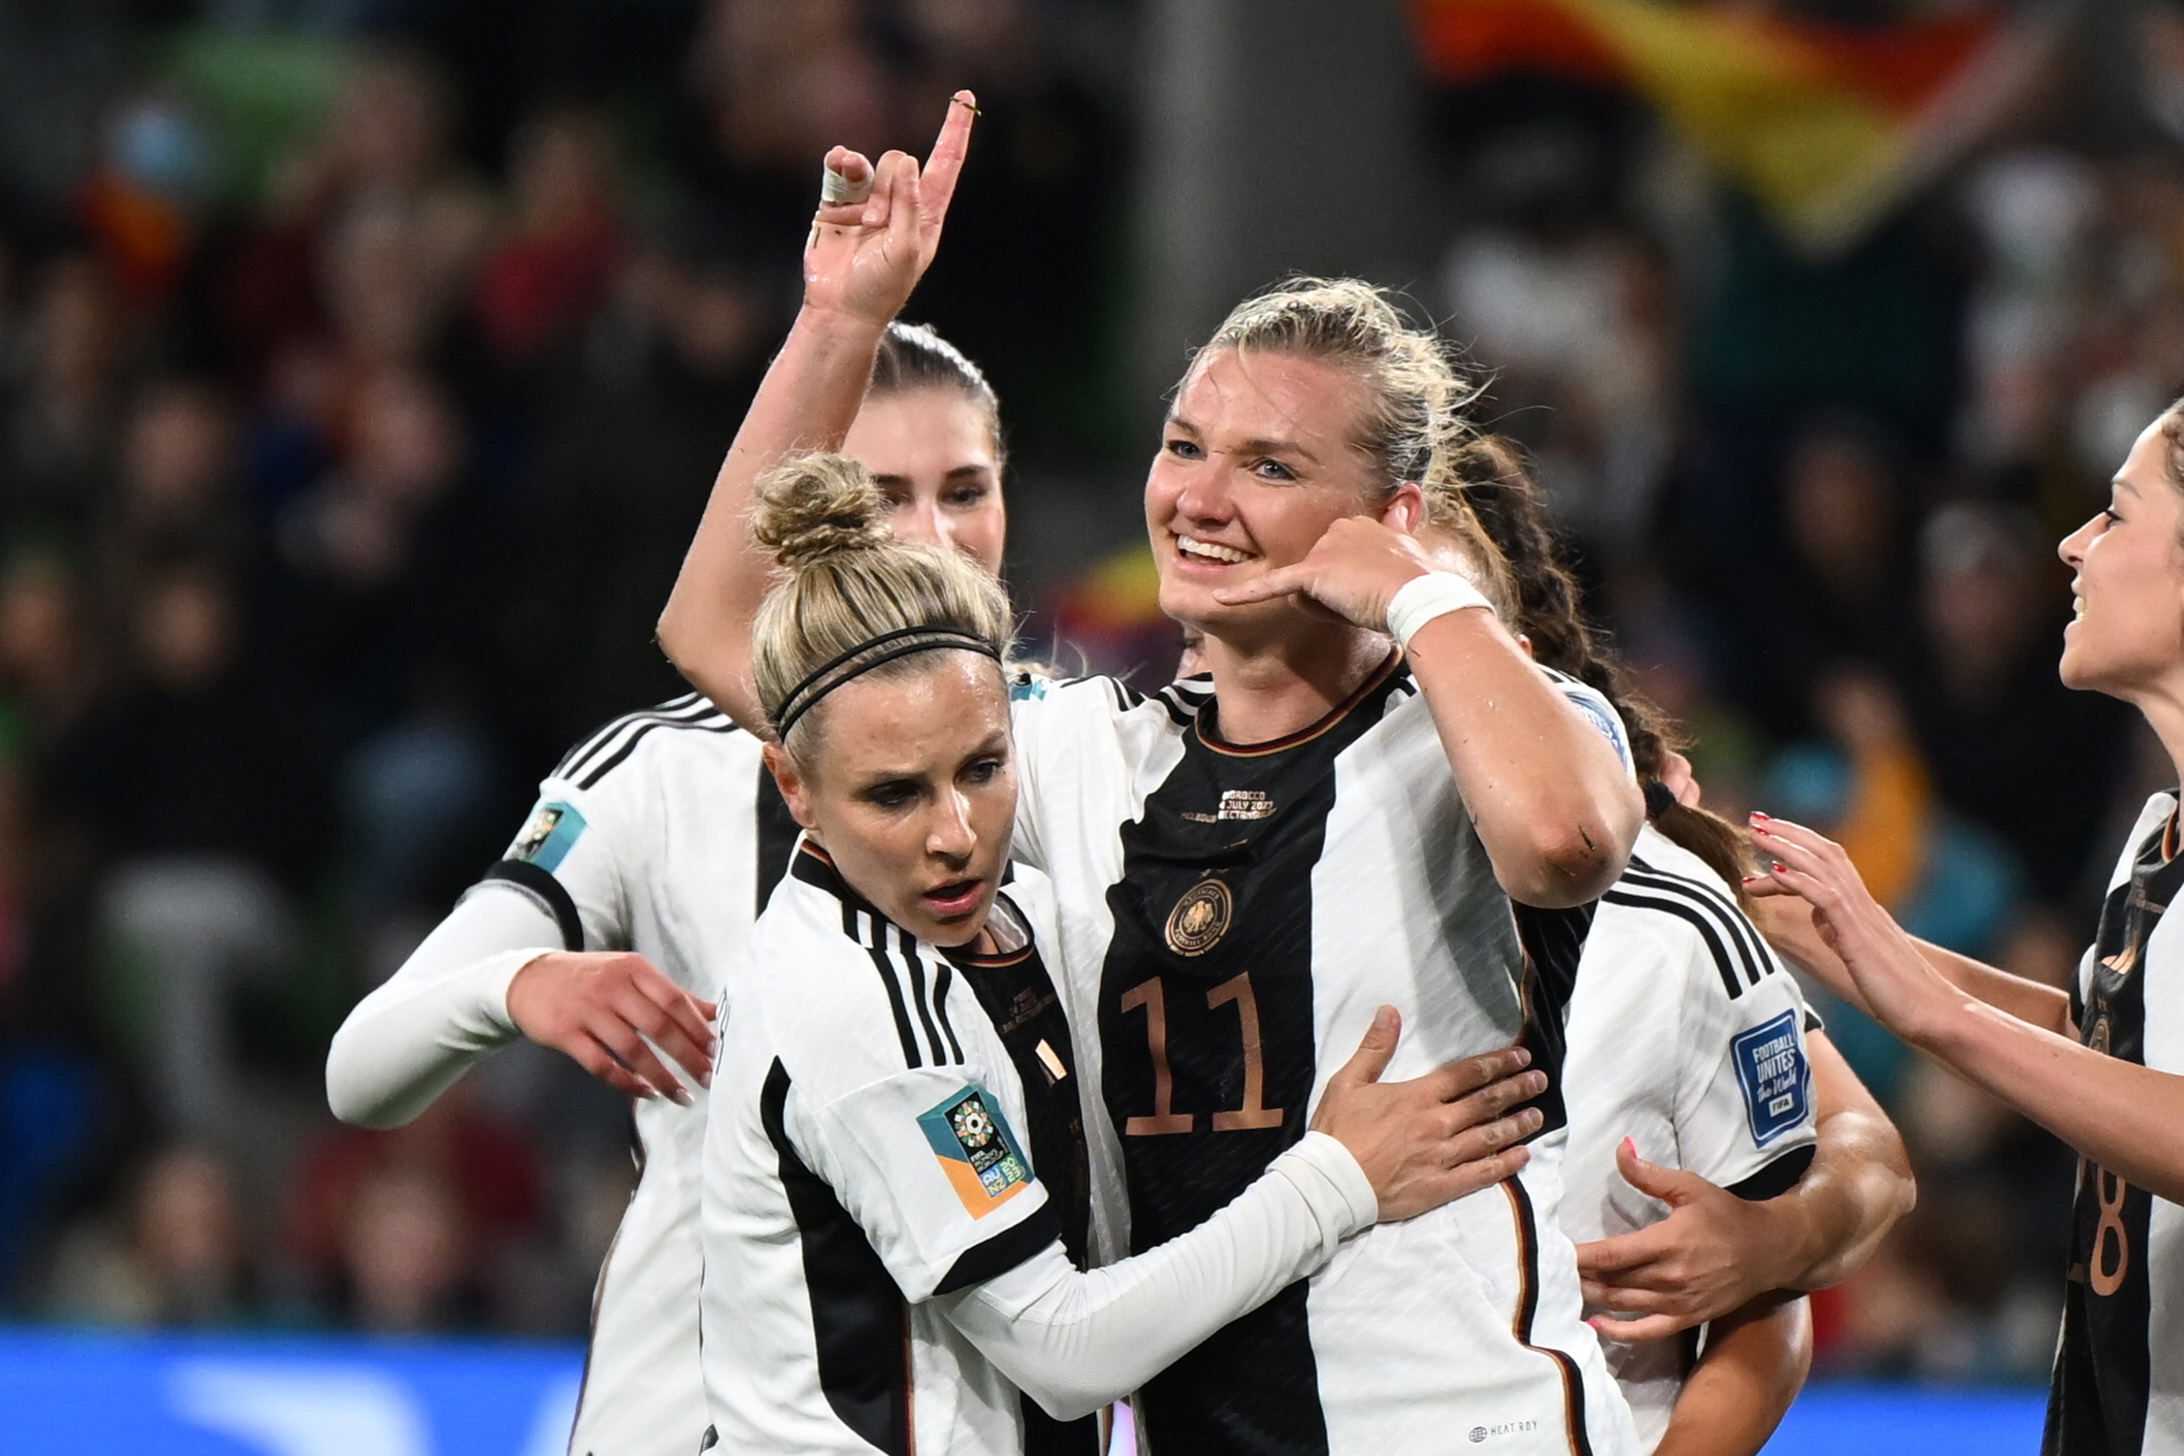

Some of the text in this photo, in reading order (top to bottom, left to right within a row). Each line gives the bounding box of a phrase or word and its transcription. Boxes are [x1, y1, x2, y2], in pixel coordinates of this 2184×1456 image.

[1226, 800, 1249, 809] JULY
[1121, 970, 1284, 1136] 11
[1752, 1033, 1795, 1064] FOOTBALL
[1756, 1048, 1796, 1083] UNITES
[1773, 1067, 1797, 1095] World
[1772, 1098, 1790, 1112] FIFA
[969, 1149, 986, 1162] FIFA
[983, 1167, 999, 1185] AU
[987, 1177, 1006, 1194] NZ
